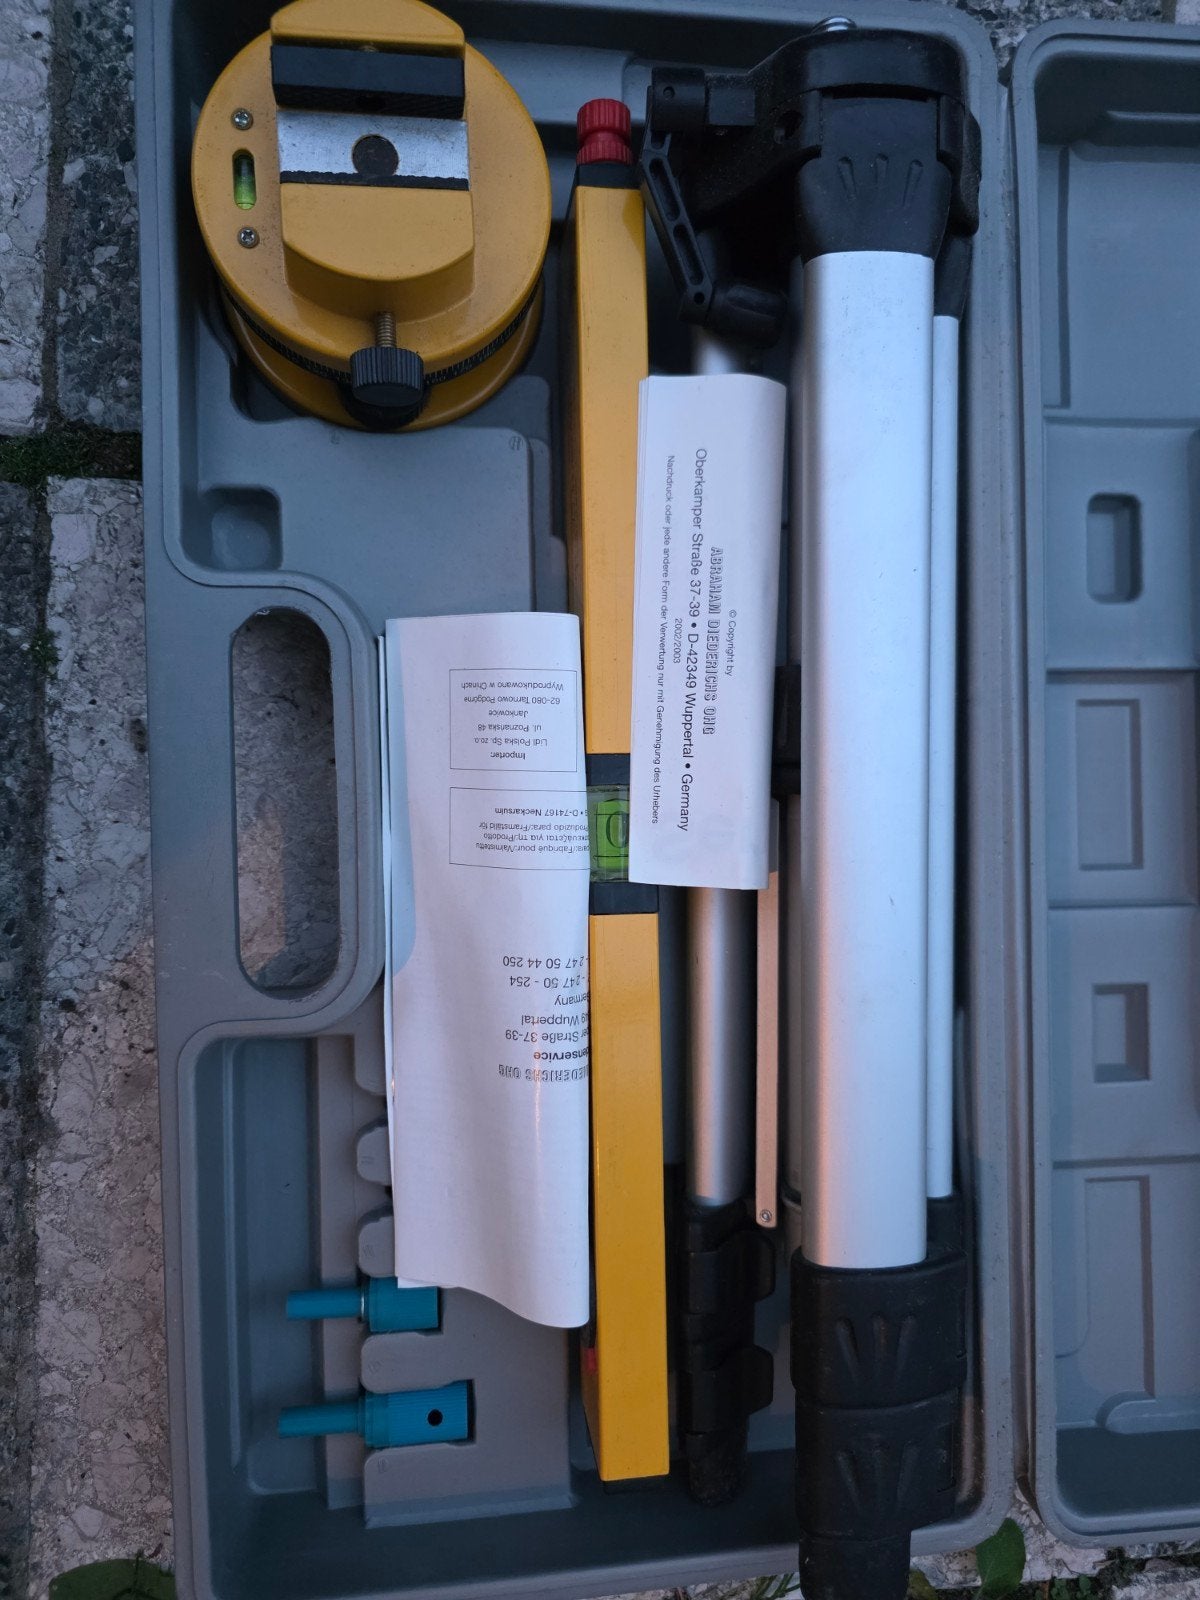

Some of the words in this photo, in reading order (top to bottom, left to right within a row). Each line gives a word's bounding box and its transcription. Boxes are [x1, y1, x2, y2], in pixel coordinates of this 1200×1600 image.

[665, 455, 675, 502] Nachdruck
[691, 448, 708, 530] Oberkamper
[664, 504, 673, 524] oder
[662, 526, 672, 546] jede
[690, 533, 704, 575] Straße
[662, 547, 671, 578] andere
[708, 546, 724, 614] ABRAHAM
[661, 580, 670, 603] Form
[689, 579, 702, 617] 37-39
[660, 604, 669, 620] der
[656, 622, 668, 670] Verwertung
[673, 618, 683, 664] 2002/2003
[725, 620, 737, 663] Copyright
[685, 633, 699, 689] D-42349
[704, 619, 720, 701] DIEDERICHS
[725, 665, 734, 677] by
[461, 682, 487, 690] Chinach
[497, 682, 564, 691] Wyprodukowano
[497, 696, 530, 704] Tarnowo
[657, 689, 665, 703] mit
[488, 709, 529, 718] Jankowice
[703, 706, 717, 735] OHG
[532, 724, 542, 733] ul.
[682, 692, 696, 758] Wuppertal
[490, 737, 503, 746] Sp.
[504, 738, 531, 747] Polska
[532, 738, 548, 747] Lidl
[653, 705, 665, 765] Genehmigung
[653, 767, 662, 783] des
[652, 785, 661, 824] Urhebers
[677, 773, 693, 832] Germany
[494, 808, 542, 817] Neckarsulm
[502, 956, 524, 968] 250
[527, 958, 542, 969] 44
[545, 958, 561, 969] 50
[509, 975, 531, 988] 254
[543, 977, 559, 989] 50
[521, 1014, 580, 1026] Wuppertal
[505, 1029, 538, 1043] 37-39
[541, 1031, 579, 1044] Straße
[498, 1064, 521, 1080] OHG
